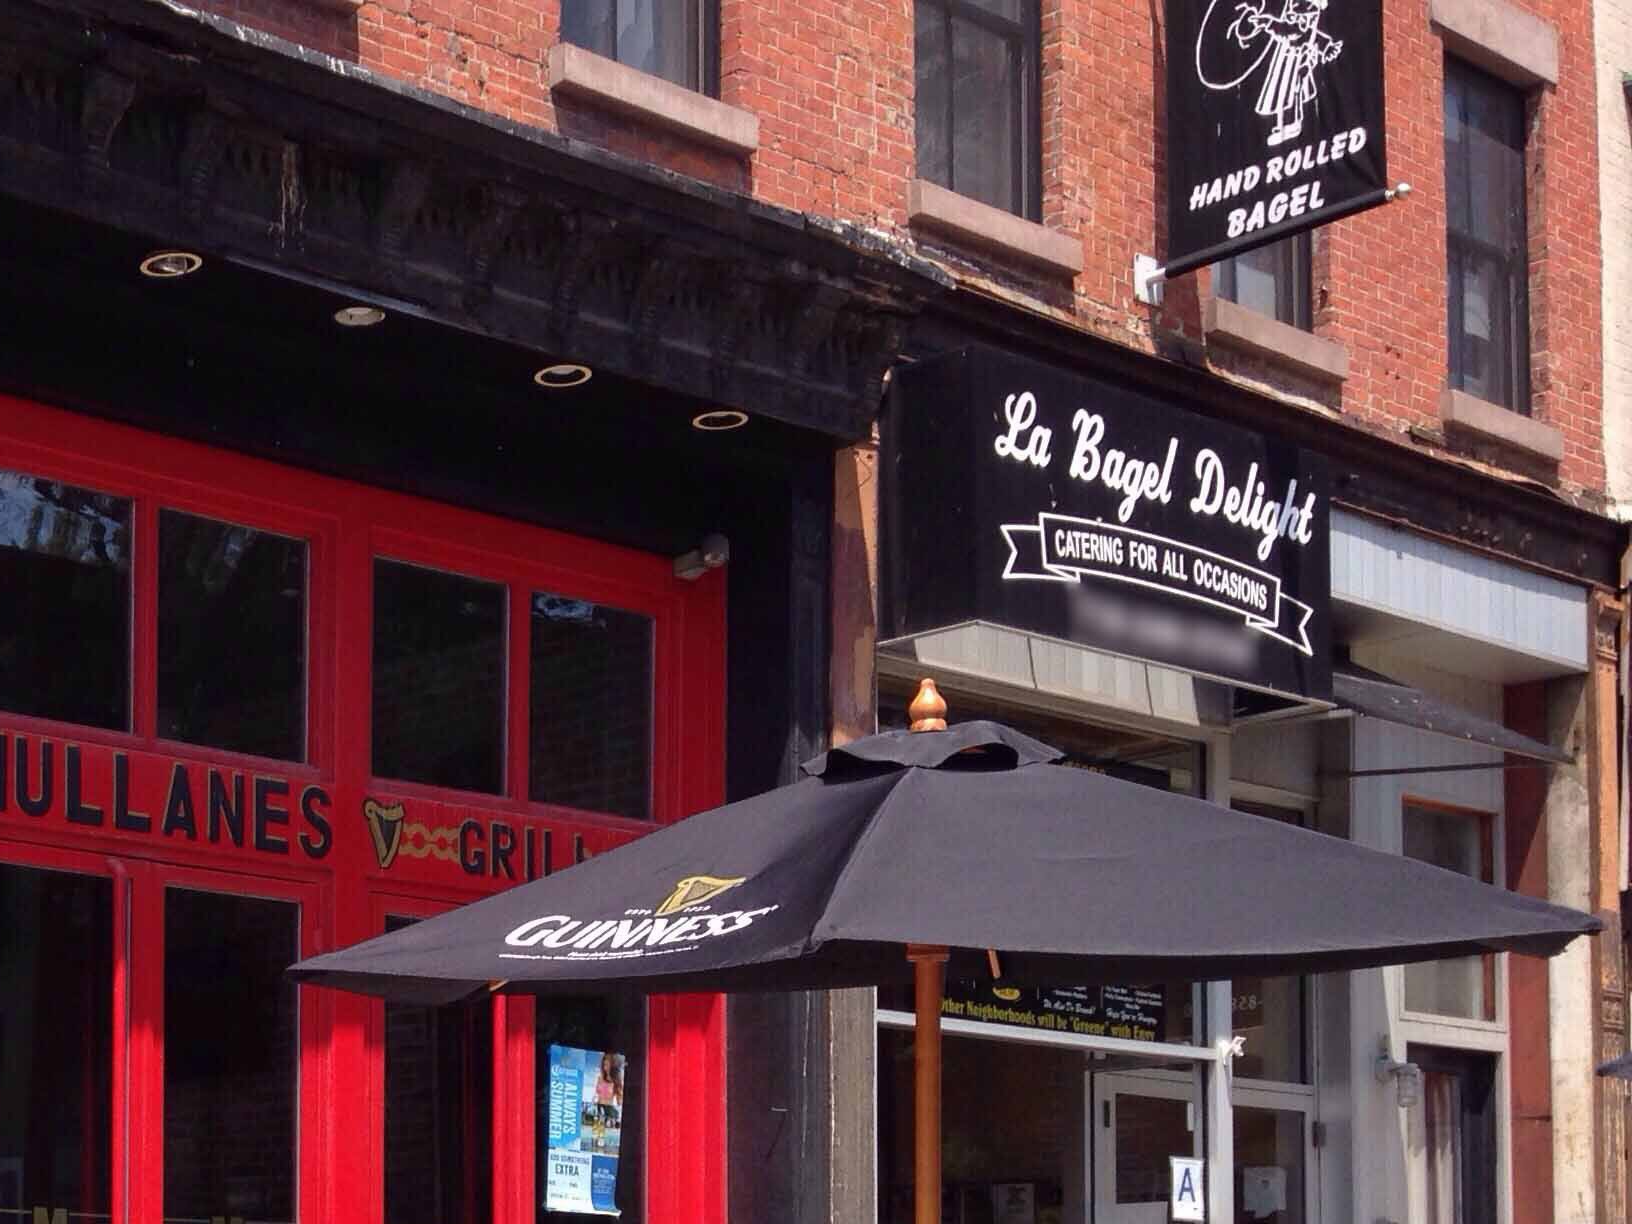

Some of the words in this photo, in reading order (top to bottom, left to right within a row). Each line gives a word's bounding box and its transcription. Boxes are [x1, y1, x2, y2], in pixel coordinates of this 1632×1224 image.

[1189, 165, 1261, 211] HAND
[1266, 127, 1367, 183] ROLLED
[1226, 181, 1325, 238] BAGEL
[994, 391, 1053, 468] La
[1069, 408, 1179, 523] Bagel
[1190, 448, 1317, 561] Delight
[1055, 529, 1124, 565] CATERING
[1129, 541, 1158, 573] FOR
[1162, 550, 1188, 581] ALL
[1193, 559, 1268, 611] OCCASIONS
[504, 905, 779, 949] GUINNESS
[549, 1081, 564, 1139] SUMMER
[563, 1083, 578, 1135] ALWAYS
[555, 1163, 580, 1177] EXTRA
[1178, 1167, 1196, 1202] A
